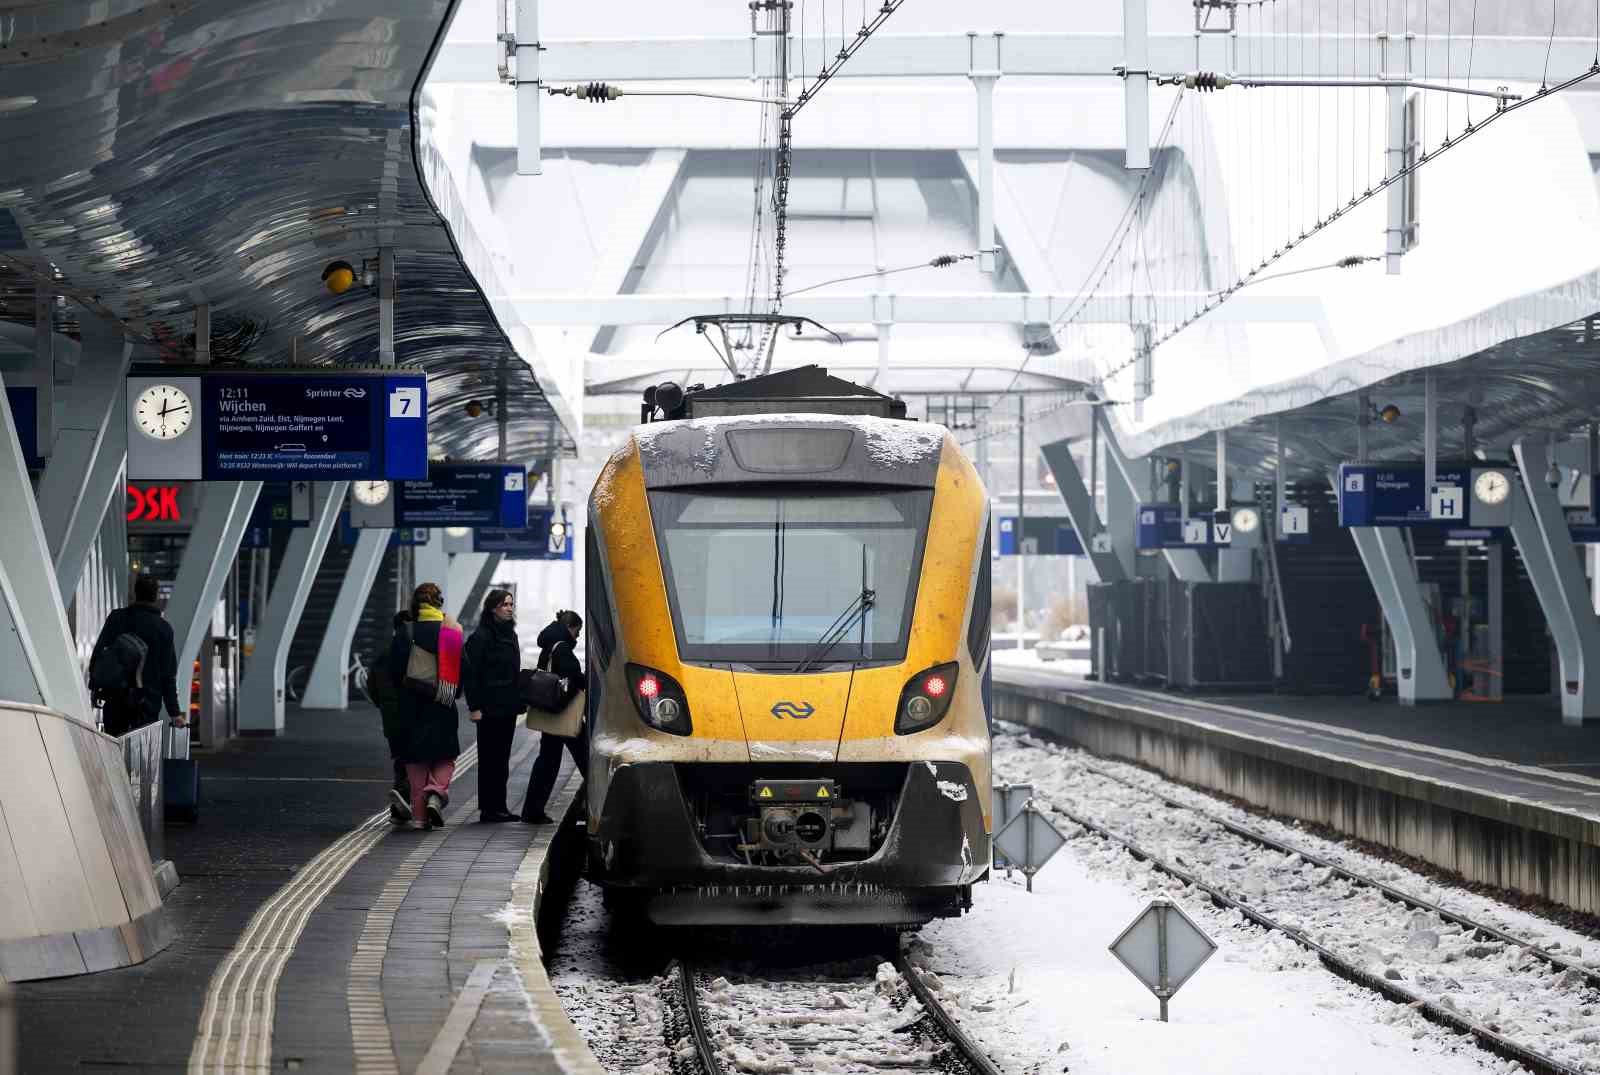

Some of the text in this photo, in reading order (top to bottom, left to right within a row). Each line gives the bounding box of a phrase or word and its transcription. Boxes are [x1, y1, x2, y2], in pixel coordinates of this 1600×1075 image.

[219, 388, 248, 399] 12:11
[306, 388, 341, 399] Sprinter
[219, 400, 267, 415] Wijchen
[399, 398, 411, 415] 7
[294, 415, 326, 425] Nijmegen
[327, 415, 345, 424] Lent,
[255, 424, 289, 433] Nijmegen
[289, 424, 313, 433] Goffert
[510, 479, 518, 488] 7
[1439, 498, 1454, 516] H
[1216, 525, 1229, 541] V
